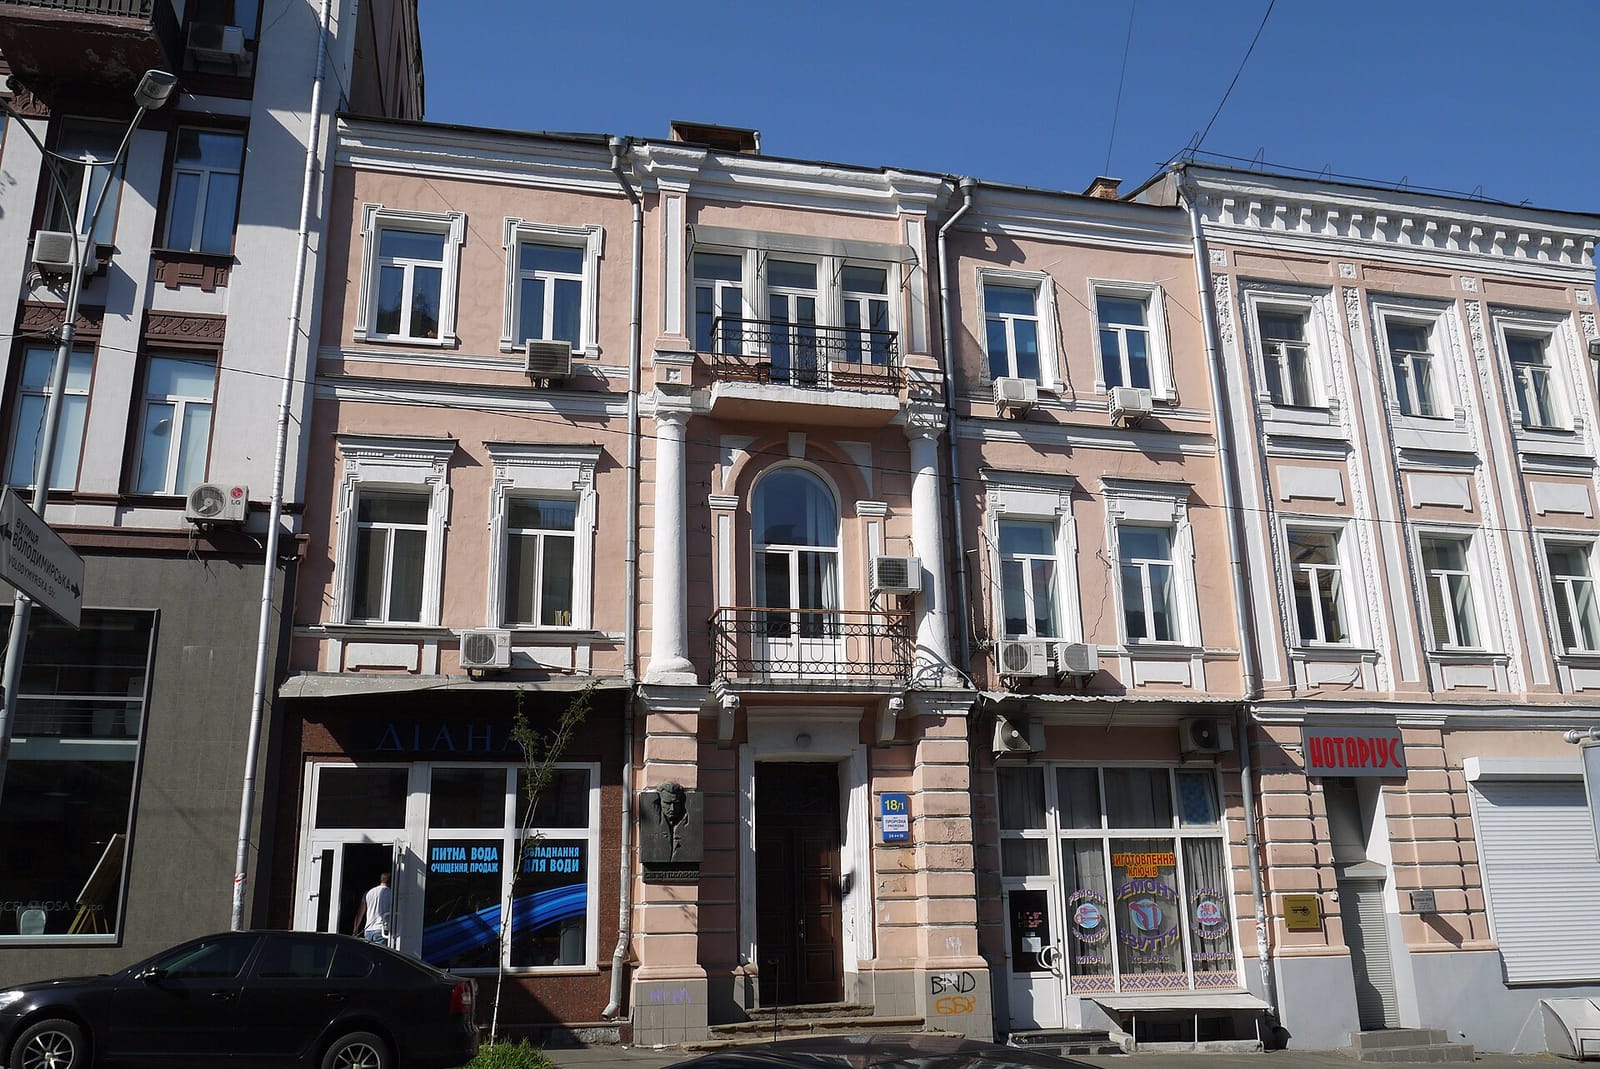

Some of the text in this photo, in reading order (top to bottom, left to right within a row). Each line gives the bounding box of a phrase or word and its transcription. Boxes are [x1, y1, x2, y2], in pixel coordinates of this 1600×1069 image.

[12, 532, 71, 592] ВОЛОДИМИРСЬКА
[375, 721, 525, 752] ДІАН
[1309, 736, 1402, 768] НОТАРІУС
[885, 799, 904, 812] 18/1
[432, 847, 498, 862] ПИТНА ВОДА
[470, 862, 499, 874] ПРОДАЖ
[524, 859, 579, 873] ДЛЯ ВОДИ
[1128, 867, 1159, 877] КЛЮЧІВ
[1115, 879, 1180, 905] РЕМОНТ
[1120, 925, 1180, 952] ВЗУТТЯ
